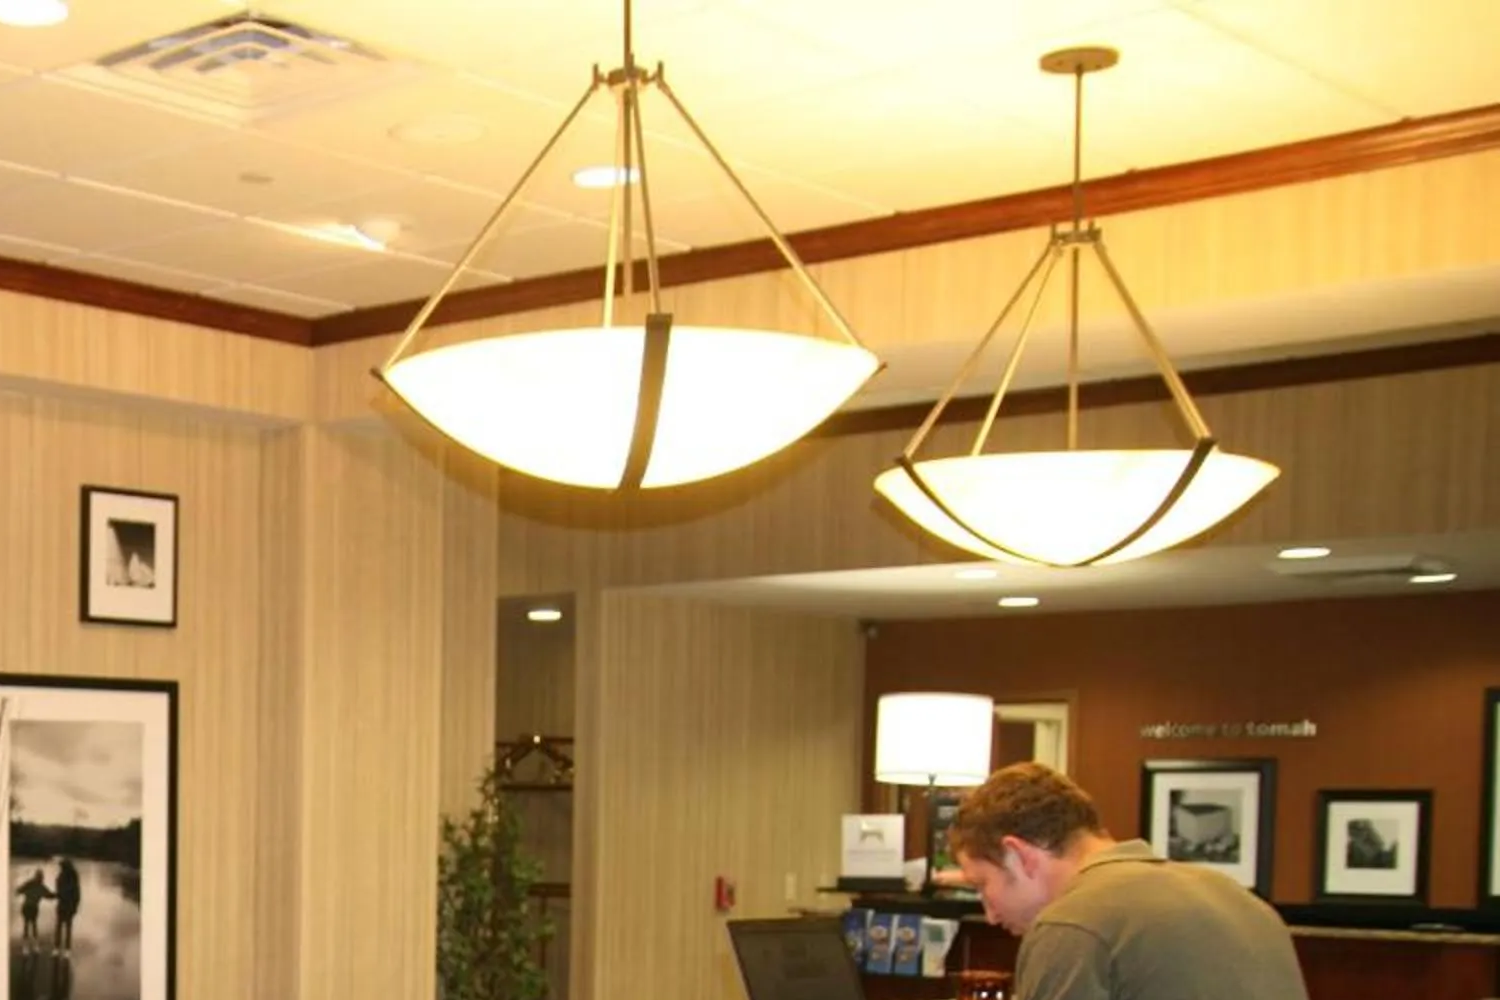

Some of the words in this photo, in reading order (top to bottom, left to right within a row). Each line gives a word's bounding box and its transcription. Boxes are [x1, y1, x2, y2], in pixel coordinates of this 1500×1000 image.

[1141, 721, 1215, 738] welcome
[1222, 723, 1241, 737] to
[1246, 720, 1317, 737] tomah
